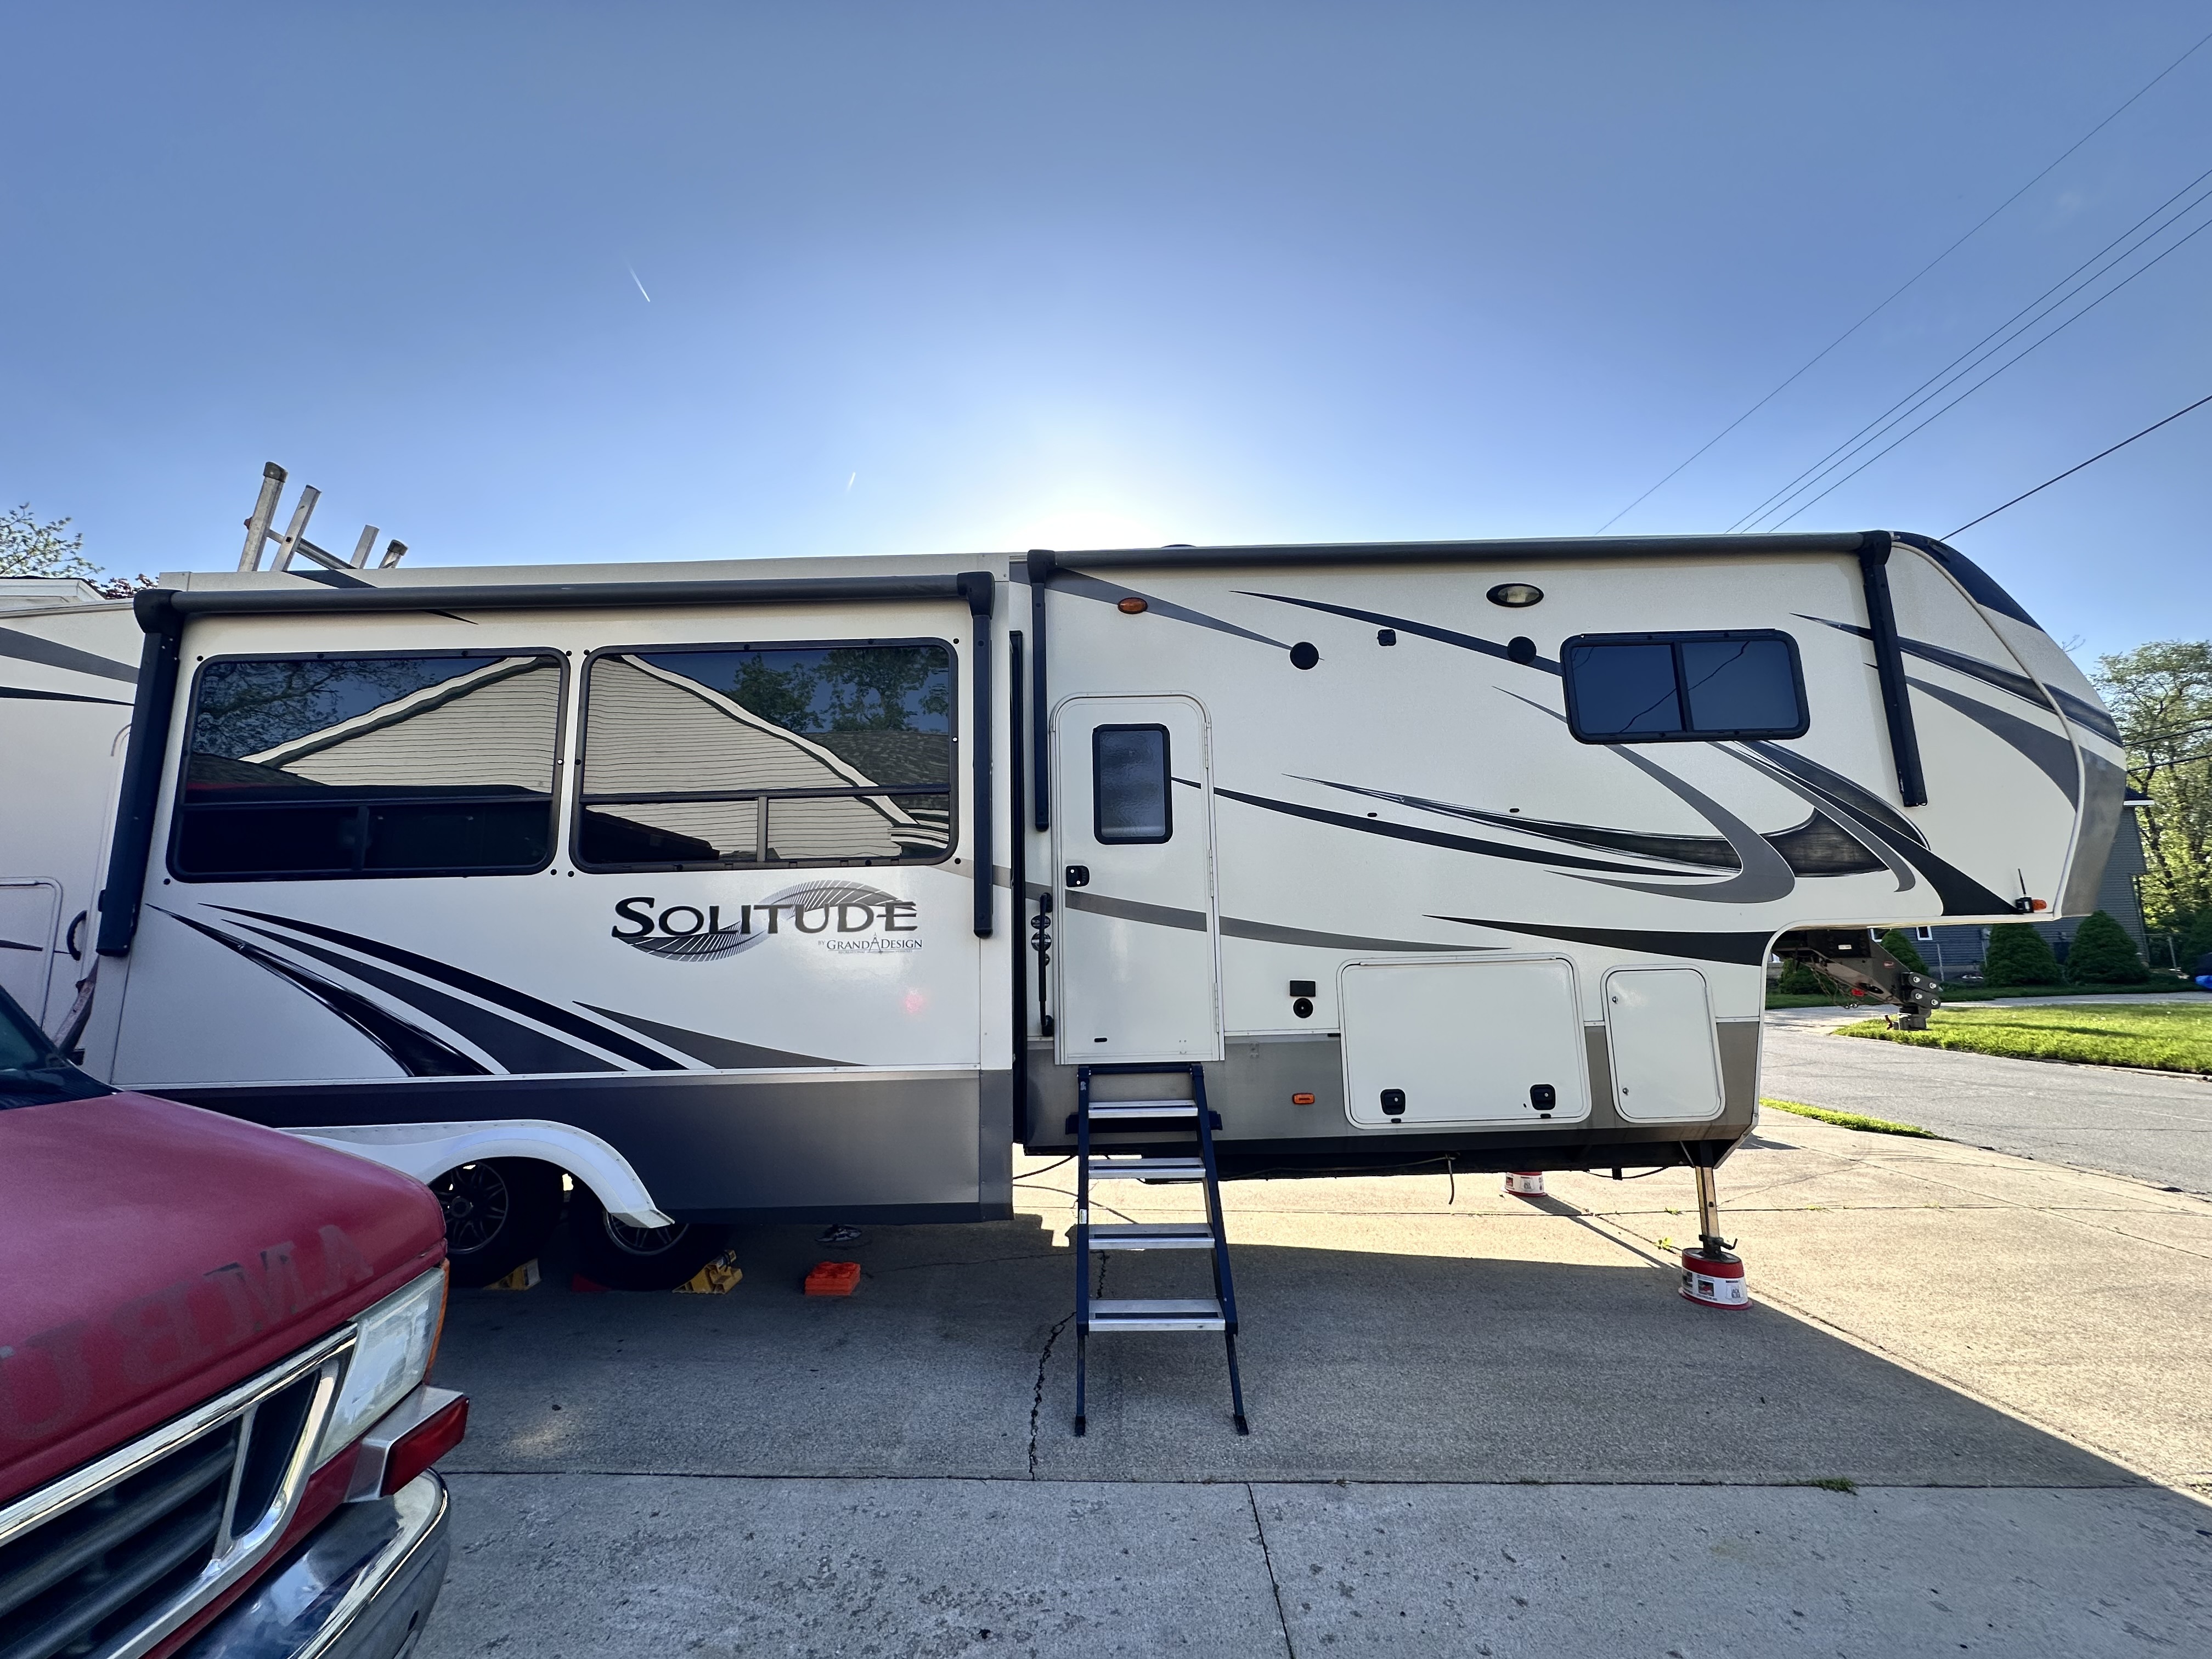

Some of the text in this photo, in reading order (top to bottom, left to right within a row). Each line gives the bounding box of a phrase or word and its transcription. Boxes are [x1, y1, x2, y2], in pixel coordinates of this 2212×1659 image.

[611, 896, 918, 938] SOLITUDE
[827, 939, 870, 950] GRAND
[881, 939, 922, 949] DESIGN
